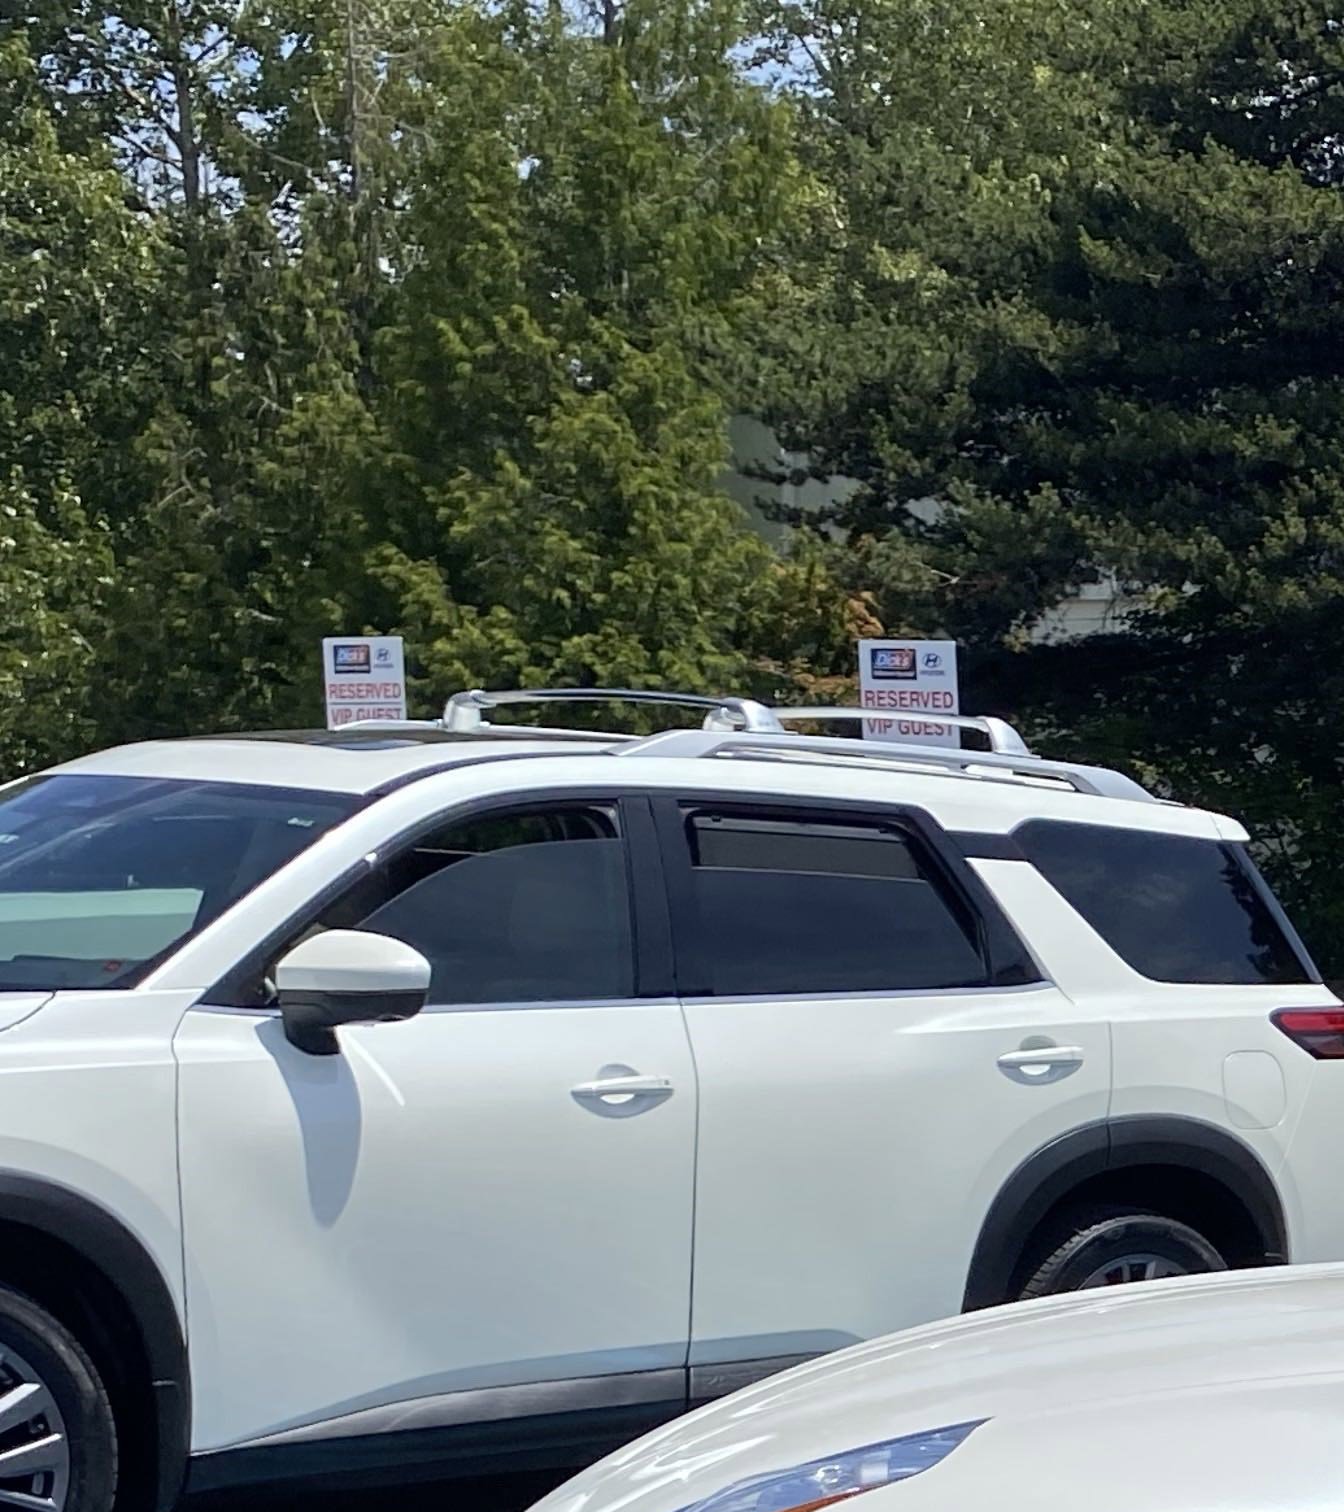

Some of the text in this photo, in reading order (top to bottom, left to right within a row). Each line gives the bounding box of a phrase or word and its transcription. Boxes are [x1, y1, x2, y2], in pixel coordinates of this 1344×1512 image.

[328, 682, 402, 699] RESERVED
[864, 689, 954, 709] RESERVED
[331, 707, 402, 725] VIP GUEST
[867, 718, 893, 735] VIP
